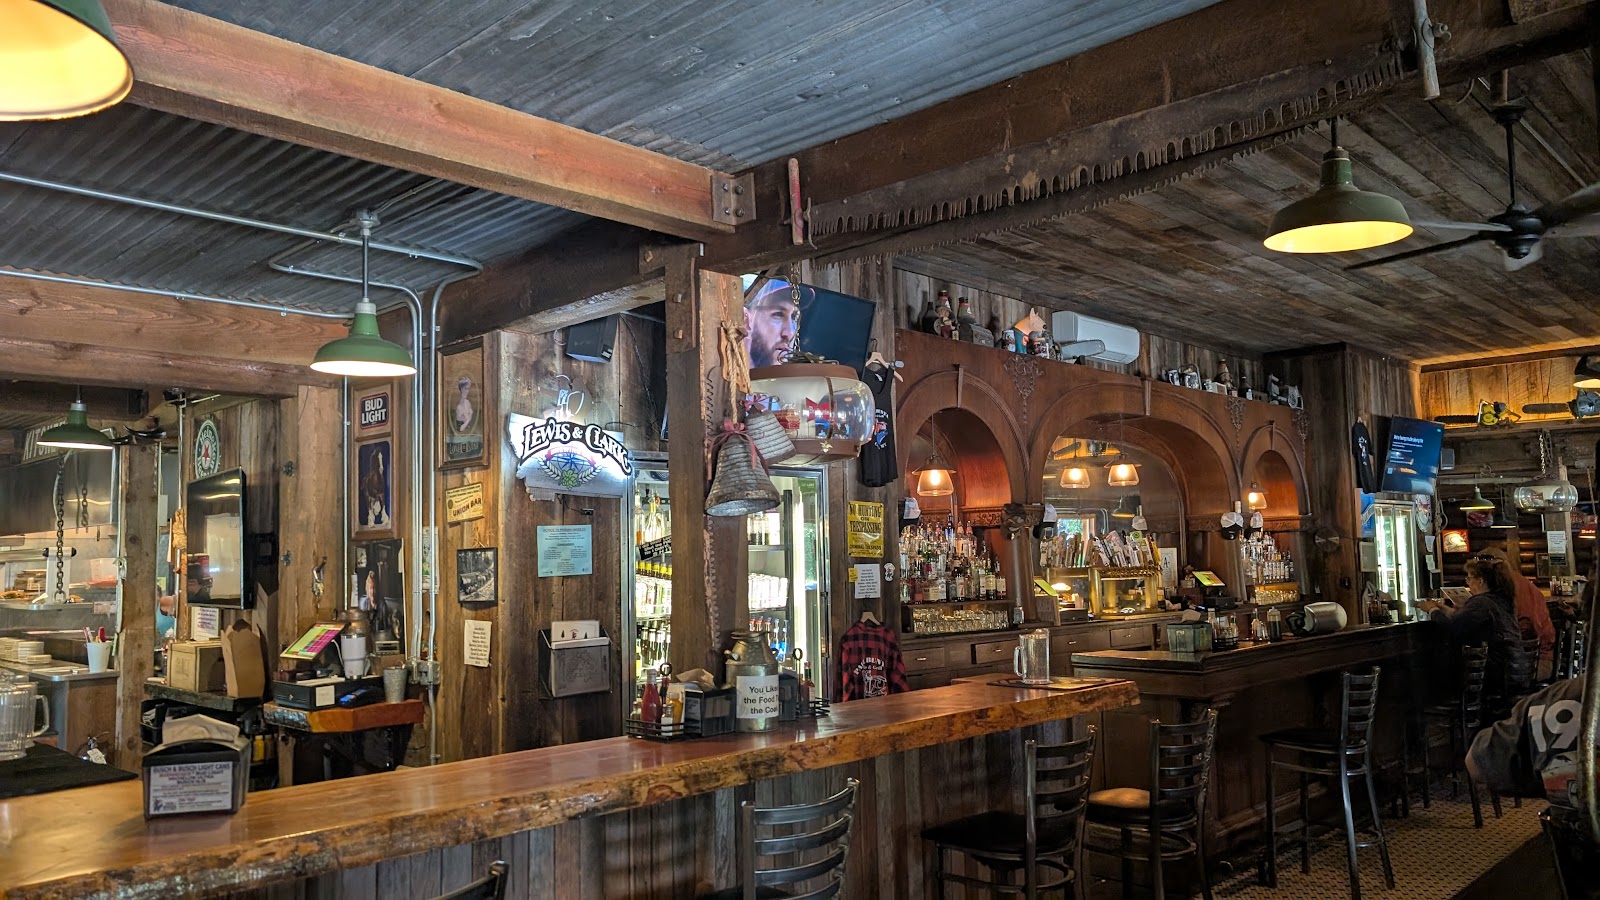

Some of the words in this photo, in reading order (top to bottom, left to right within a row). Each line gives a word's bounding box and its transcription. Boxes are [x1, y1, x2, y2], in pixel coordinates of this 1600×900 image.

[365, 398, 383, 411] BUD
[361, 409, 387, 424] LIGHT
[522, 418, 571, 460] LEWIS
[572, 426, 583, 439] &
[585, 423, 633, 474] CLARK
[453, 502, 470, 517] UNION
[470, 497, 482, 508] BAR
[858, 505, 881, 519] HUNTING
[850, 520, 881, 534] TRESPASSING
[749, 686, 764, 694] You
[744, 696, 757, 704] the
[759, 695, 775, 704] Food
[1528, 699, 1583, 753] 19
[198, 763, 214, 771] LIGHT
[215, 762, 231, 770] CANS
